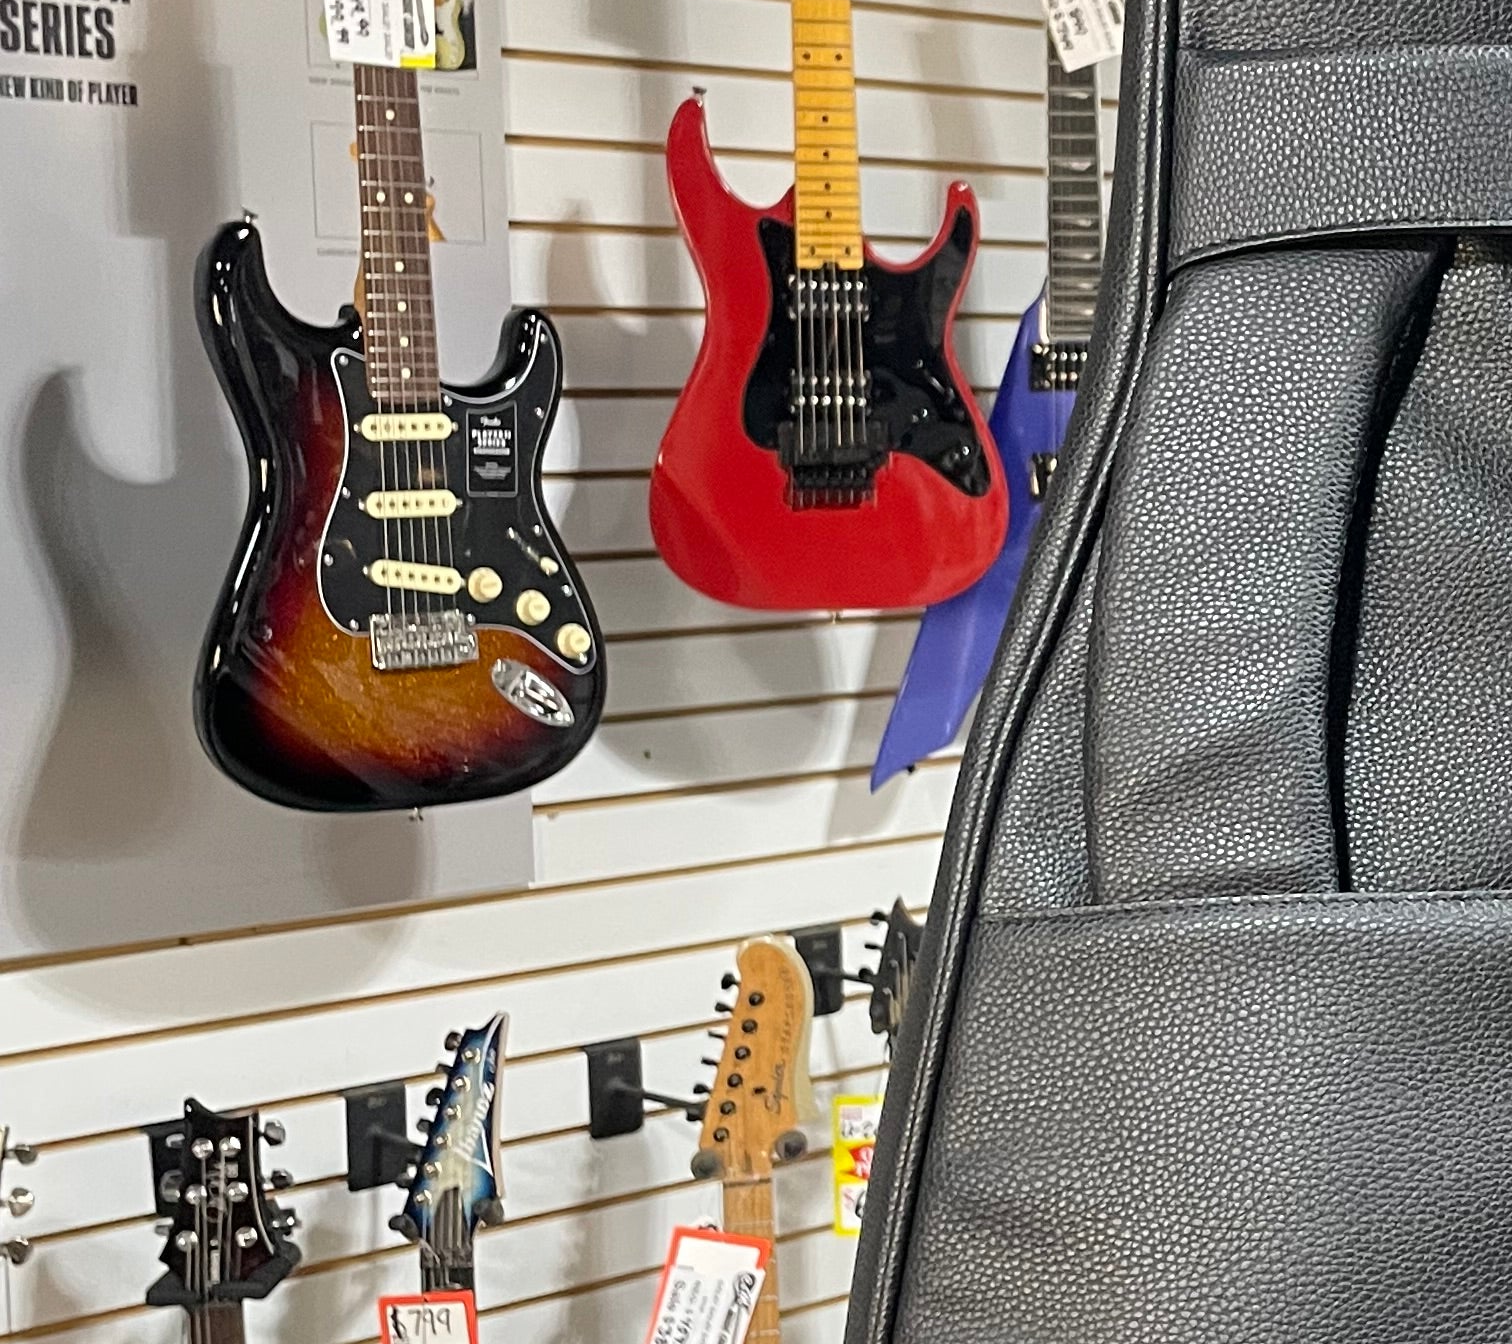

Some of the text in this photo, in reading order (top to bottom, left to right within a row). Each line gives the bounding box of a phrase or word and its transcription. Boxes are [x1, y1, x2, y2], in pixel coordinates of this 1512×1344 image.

[0, 0, 115, 60] SERIES
[68, 79, 83, 103] OF
[88, 81, 138, 106] PLAYER
